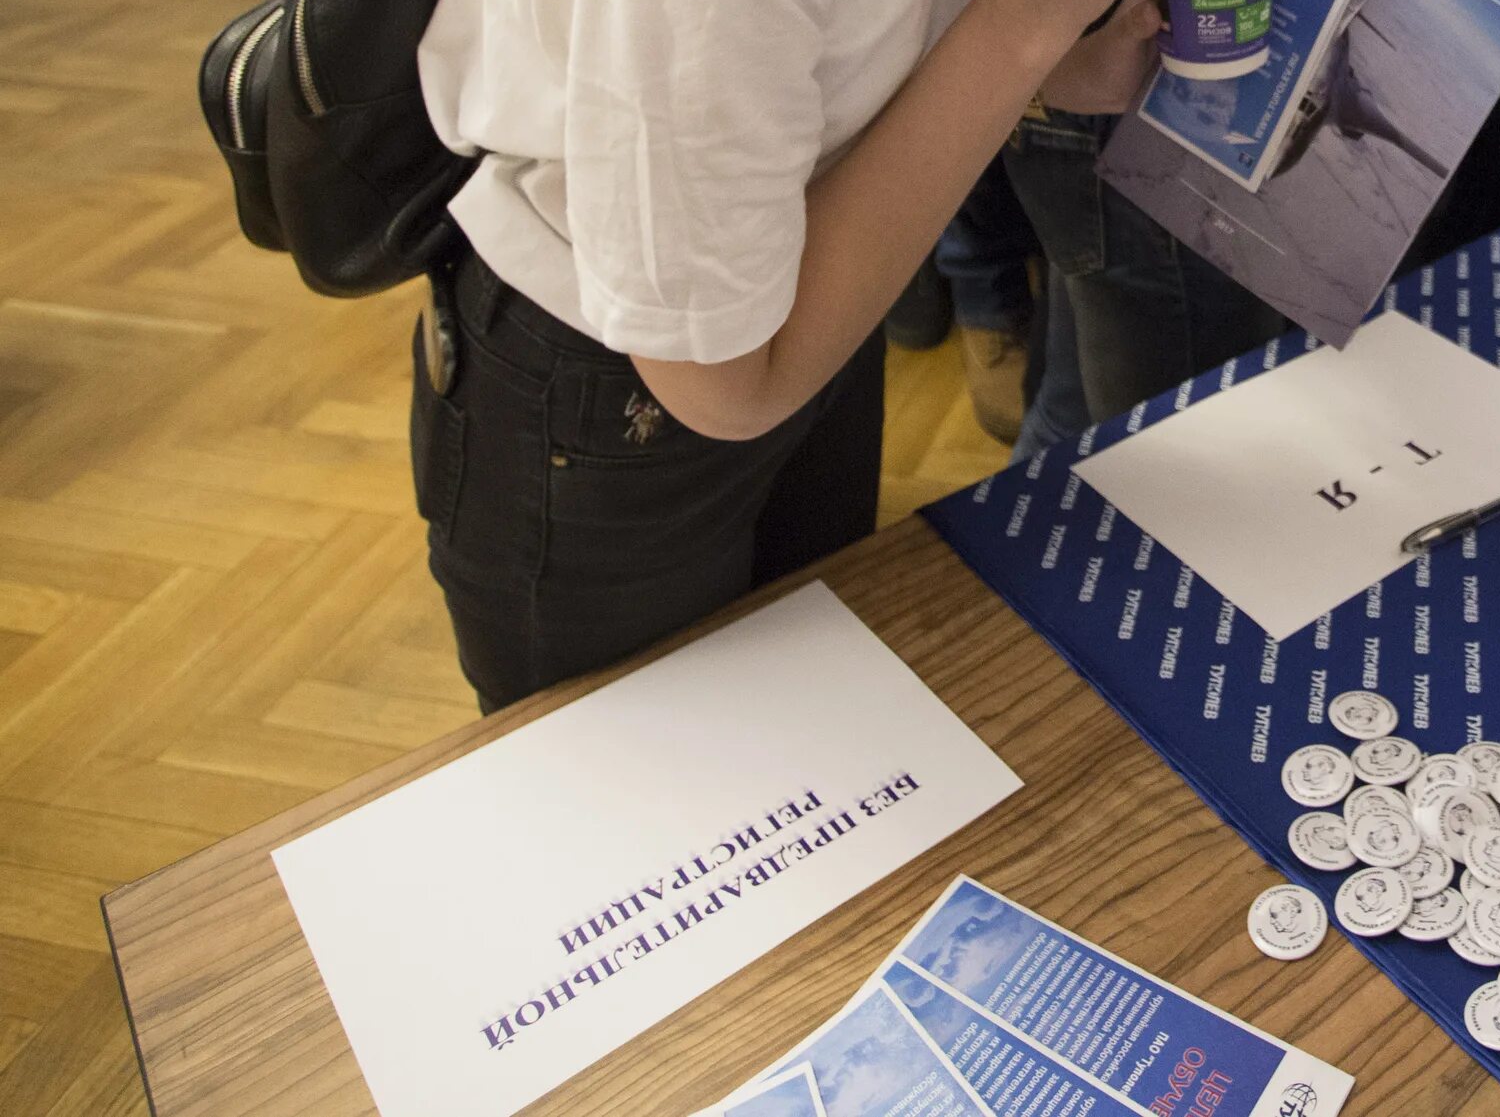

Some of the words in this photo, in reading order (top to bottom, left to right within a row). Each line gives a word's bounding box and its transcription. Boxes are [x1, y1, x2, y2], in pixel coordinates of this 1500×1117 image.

[1197, 14, 1217, 28] 22
[1402, 440, 1443, 466] Т
[1314, 479, 1358, 512] Я
[858, 769, 923, 819] БЕЗ
[557, 786, 825, 956] РЕГИСТРАЦИИ
[479, 809, 860, 1052] ПРЕДВАРИТЕЛЬНОЙ
[1015, 936, 1059, 988] эксплуатации
[1042, 948, 1082, 997] внедрением
[1054, 955, 1093, 1003] назначения,
[993, 991, 1017, 1018] после
[1025, 993, 1049, 1020] новых
[1065, 961, 1105, 1011] летательных
[1069, 967, 1117, 1028] производством
[1083, 974, 1128, 1032] занимающаяся
[1100, 980, 1140, 1033] авиационной
[1026, 998, 1061, 1040] создание
[1039, 1006, 1071, 1047] аппарато
[1126, 992, 1164, 1043] крупнейшая
[943, 1020, 981, 1062] обслужи
[952, 1027, 990, 1072] эксплуата
[961, 1044, 992, 1081] произво
[1062, 1028, 1090, 1062] проект
[1075, 1029, 1105, 1067] техники,
[1098, 1039, 1133, 1085] российска
[1147, 1029, 1170, 1056] ПАО
[970, 1041, 1013, 1092] внедрение
[991, 1057, 1036, 1111] летательных
[1146, 1042, 1209, 1117] ОБУЧЕ
[881, 1069, 939, 1117] обслужива
[903, 1080, 947, 1117] эксплуат
[1001, 1063, 1047, 1117] производств
[1018, 1071, 1060, 1117] занимающ
[1037, 1078, 1072, 1117] авиацио
[1057, 1086, 1084, 1117] компа
[1182, 1064, 1232, 1117] ЦЕЛ
